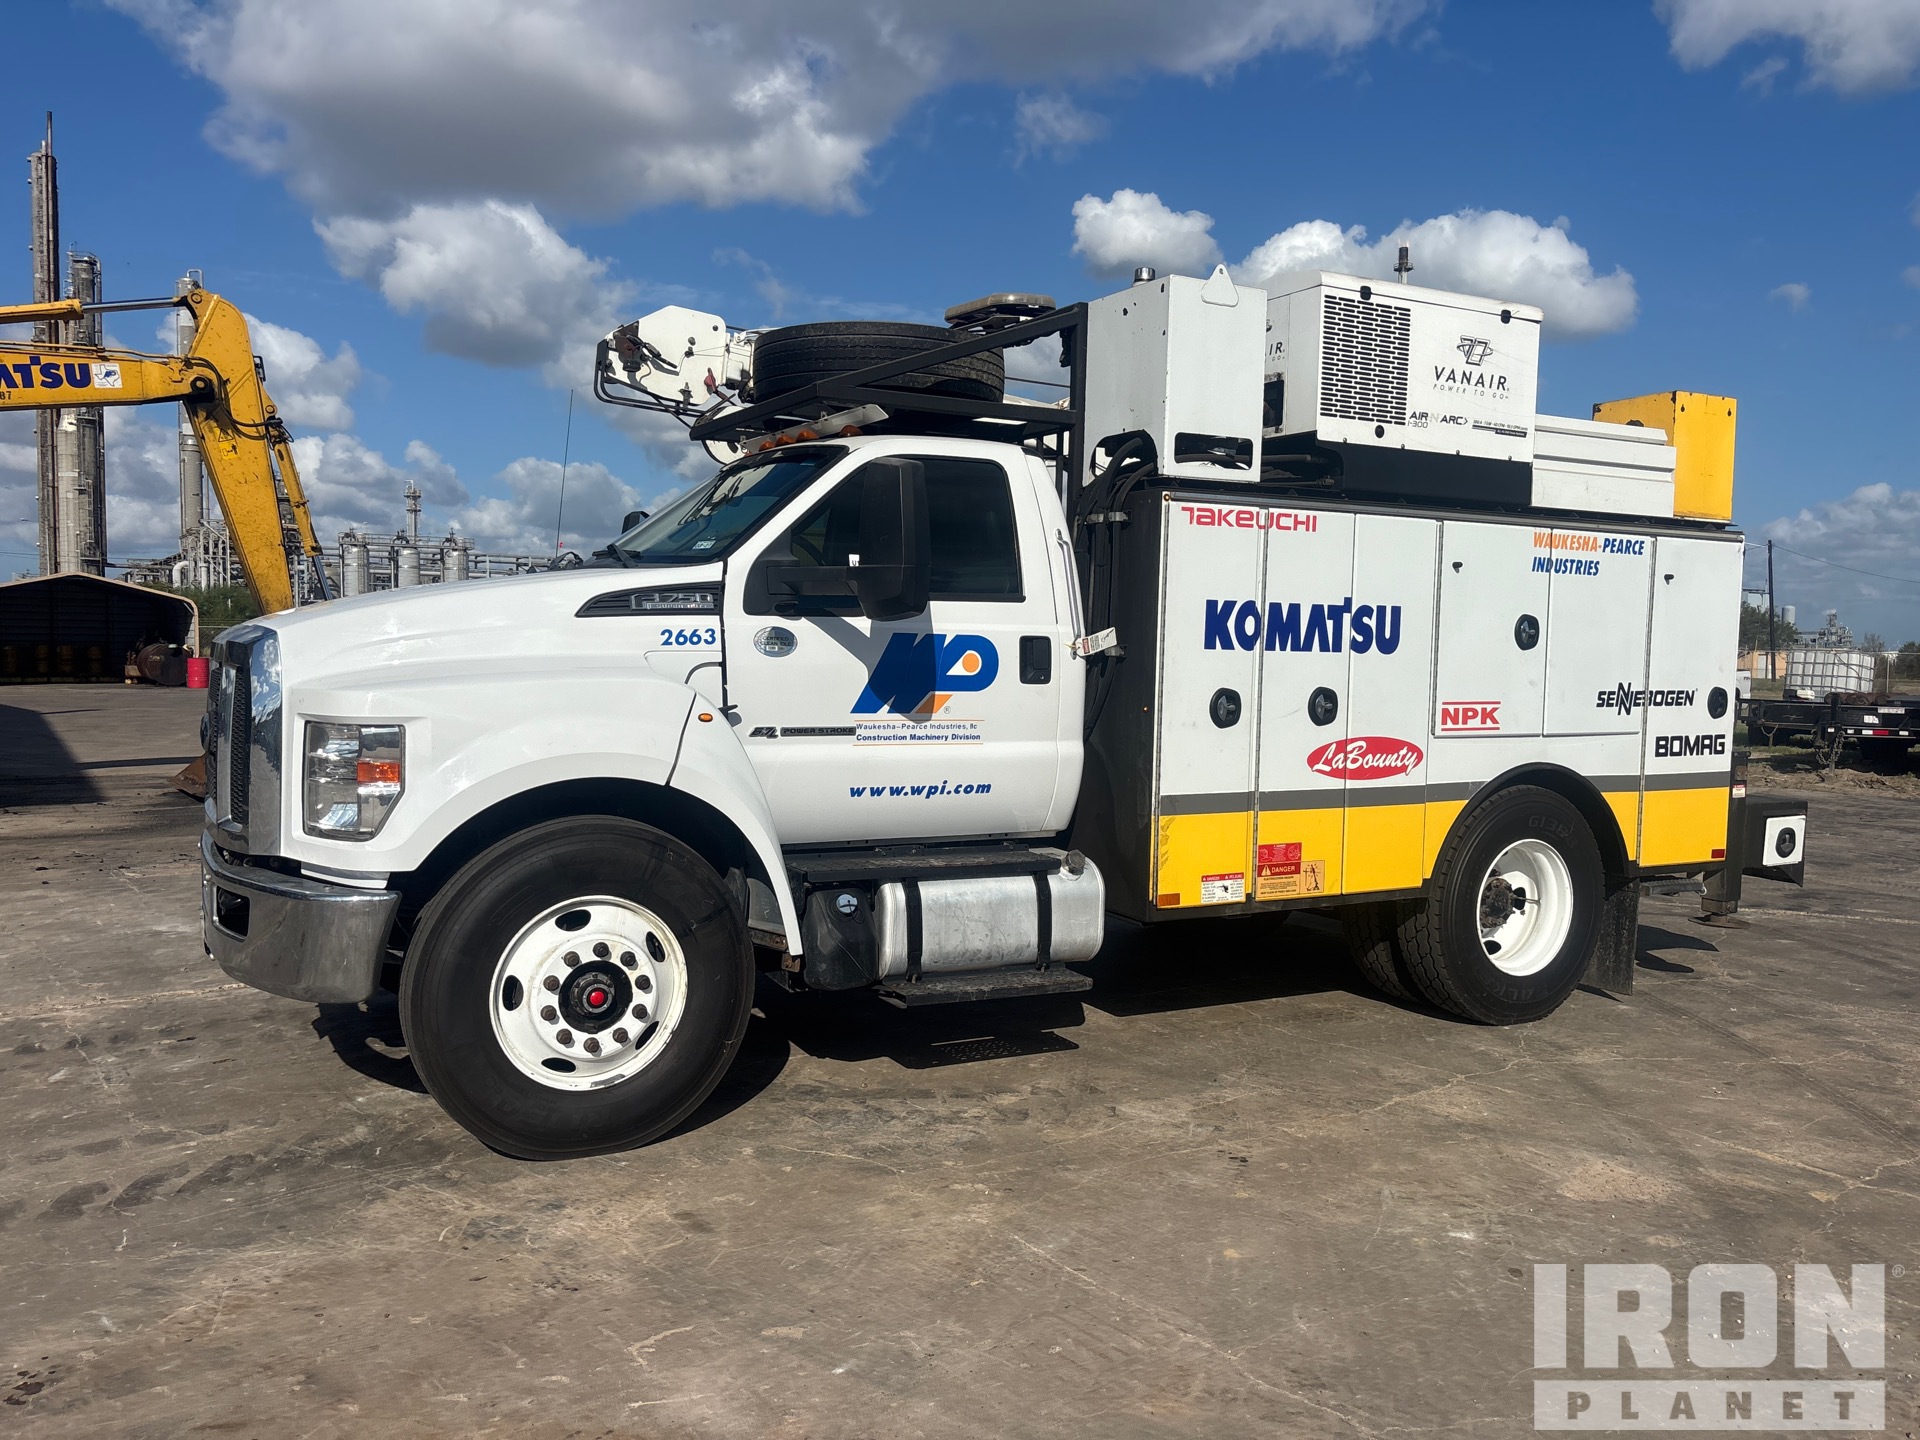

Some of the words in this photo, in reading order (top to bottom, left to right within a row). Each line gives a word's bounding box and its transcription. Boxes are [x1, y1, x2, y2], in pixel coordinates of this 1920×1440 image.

[1434, 365, 1507, 392] VANAIR
[1432, 383, 1467, 395] POWER
[1473, 389, 1485, 397] TO
[1491, 392, 1505, 400] GO
[1409, 411, 1429, 421] AIR
[1533, 531, 1646, 556] WAUKESHA-PEARCE
[1531, 556, 1600, 577] INDUSTRIES
[1203, 596, 1402, 656] KOMATSU
[660, 628, 717, 646] 2663
[1440, 707, 1501, 726] NPK
[856, 733, 908, 741] Construction
[909, 733, 949, 742] Machinery
[951, 732, 981, 741] Division
[1654, 733, 1726, 757] BOMAG
[1312, 740, 1418, 777] LaBounty
[849, 779, 992, 800] www.wpi.com
[1271, 865, 1296, 873] DANGER
